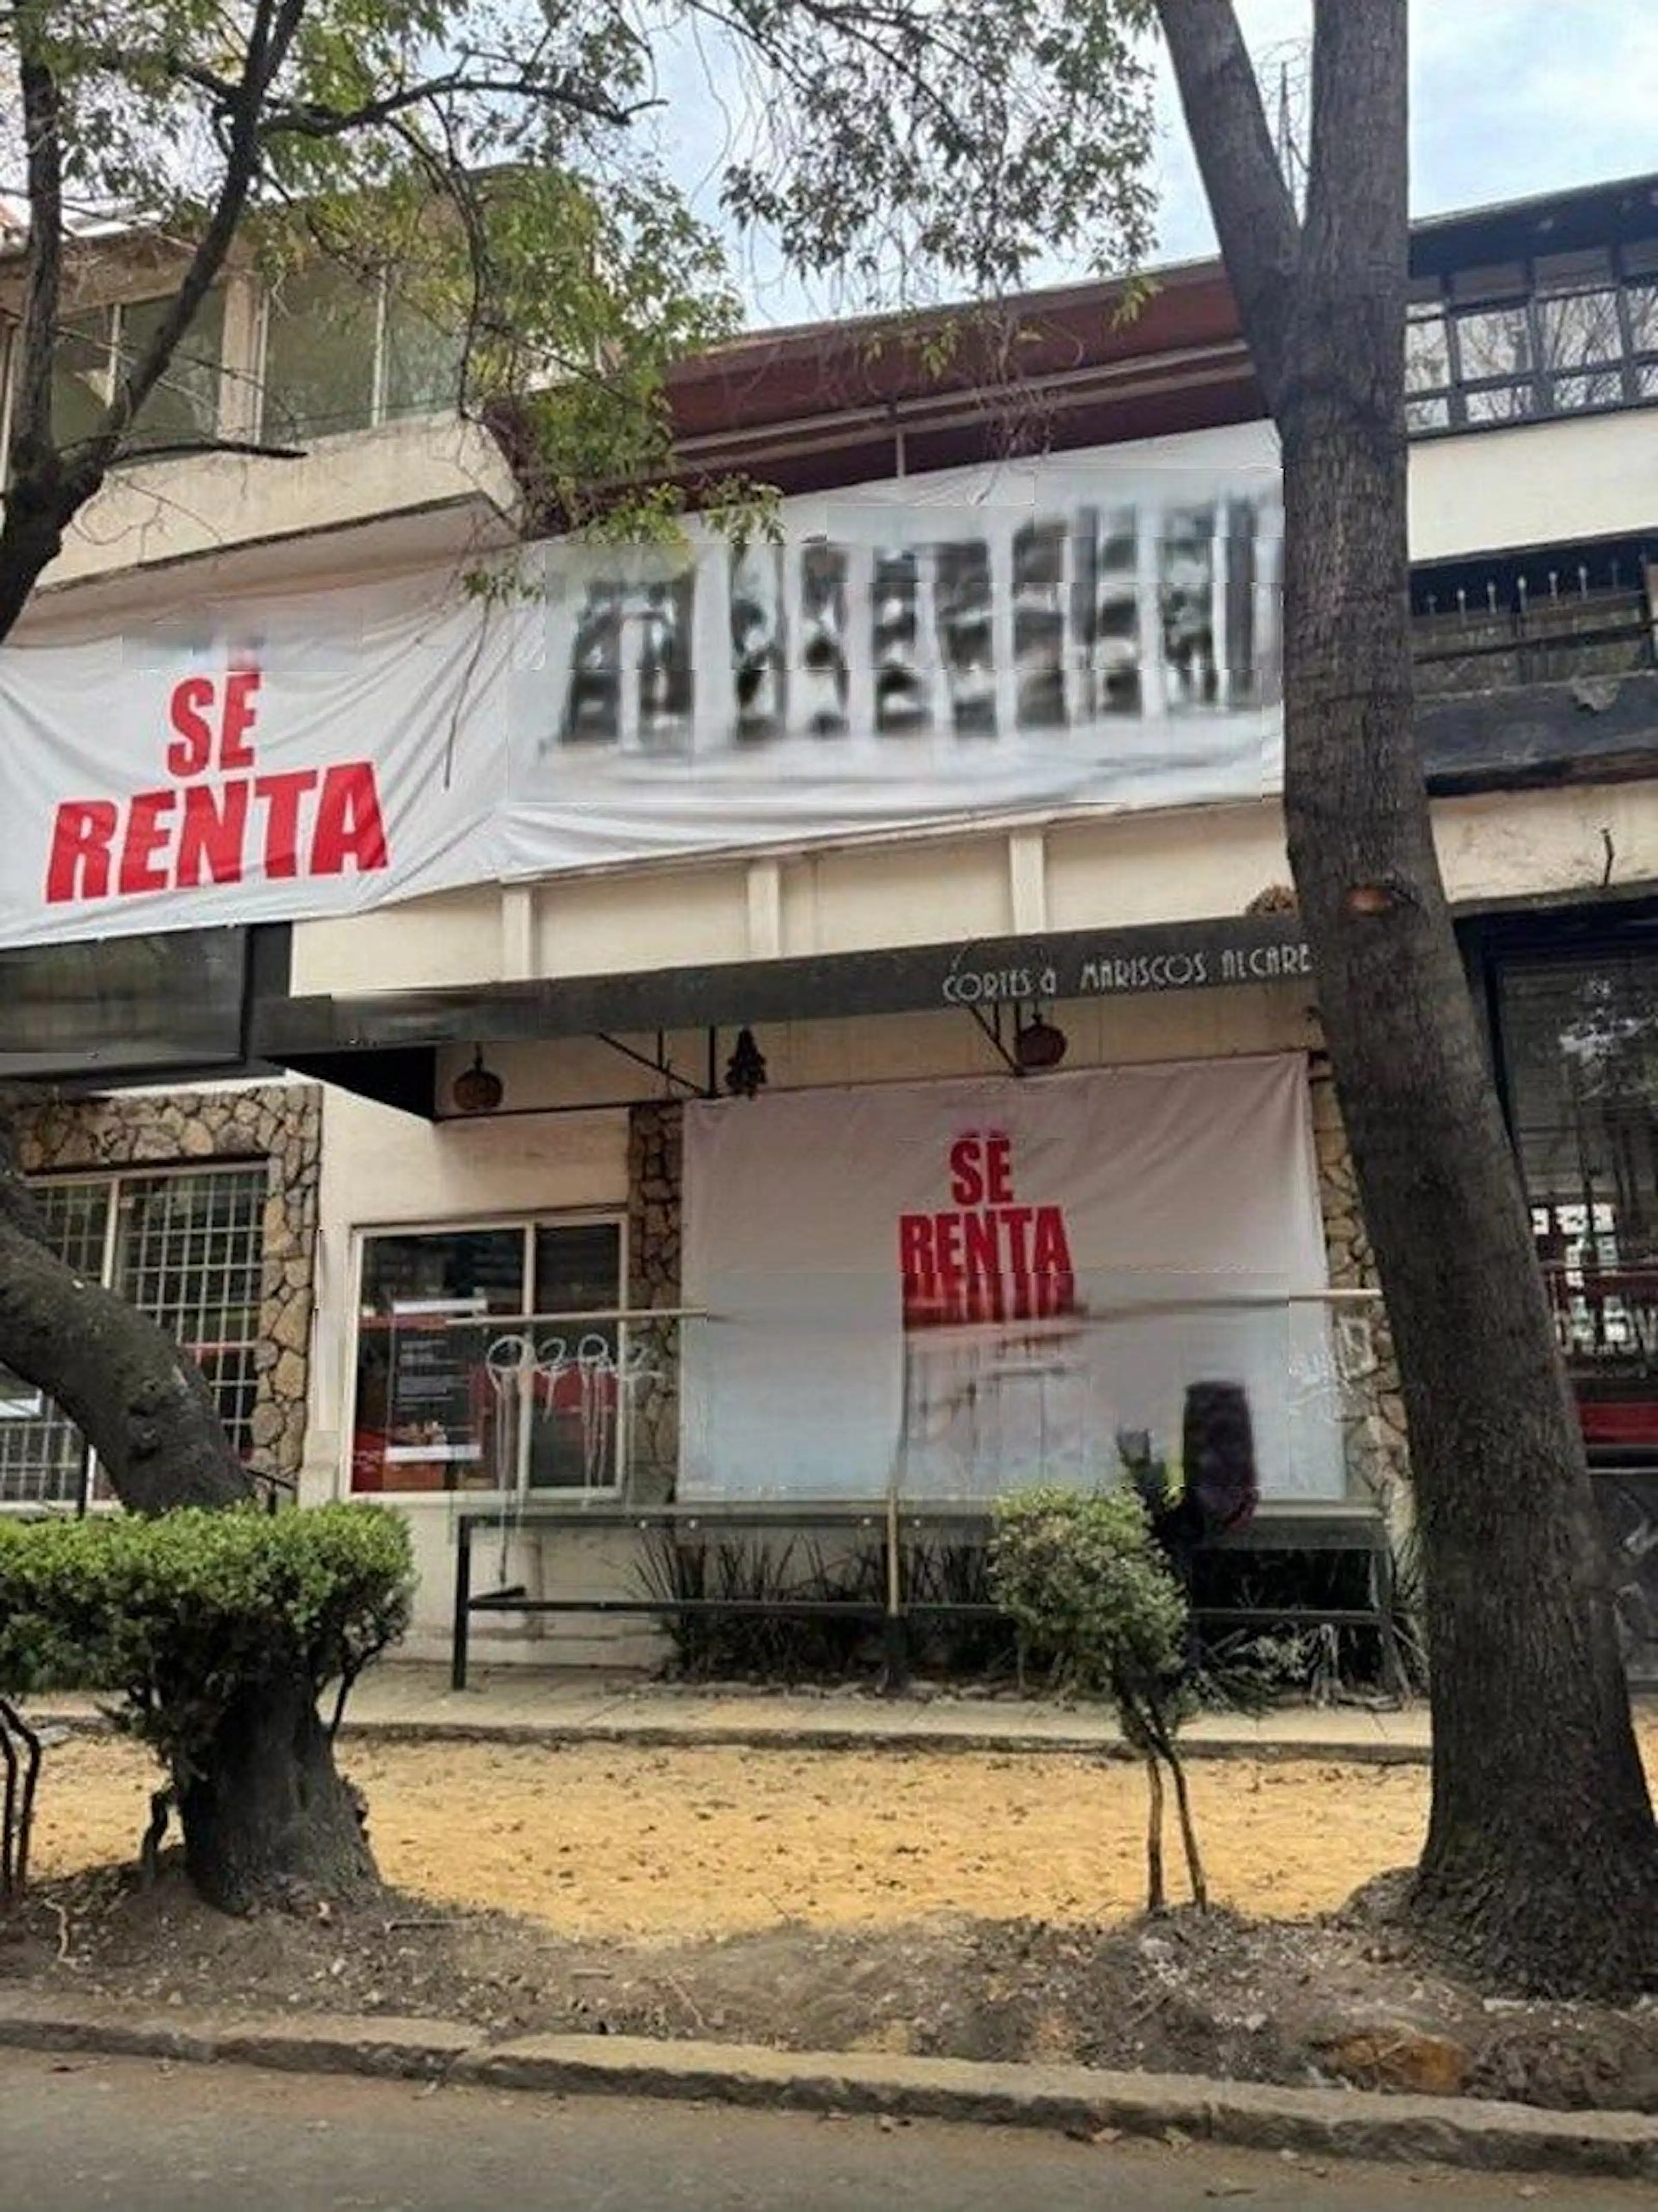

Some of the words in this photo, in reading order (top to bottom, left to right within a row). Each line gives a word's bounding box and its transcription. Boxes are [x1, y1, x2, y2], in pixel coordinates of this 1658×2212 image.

[167, 665, 262, 776] SE
[46, 761, 388, 903] RENTA
[1080, 952, 1207, 990] MARISCOS
[949, 1131, 1014, 1205] SE
[899, 1206, 1075, 1327] RENTA
